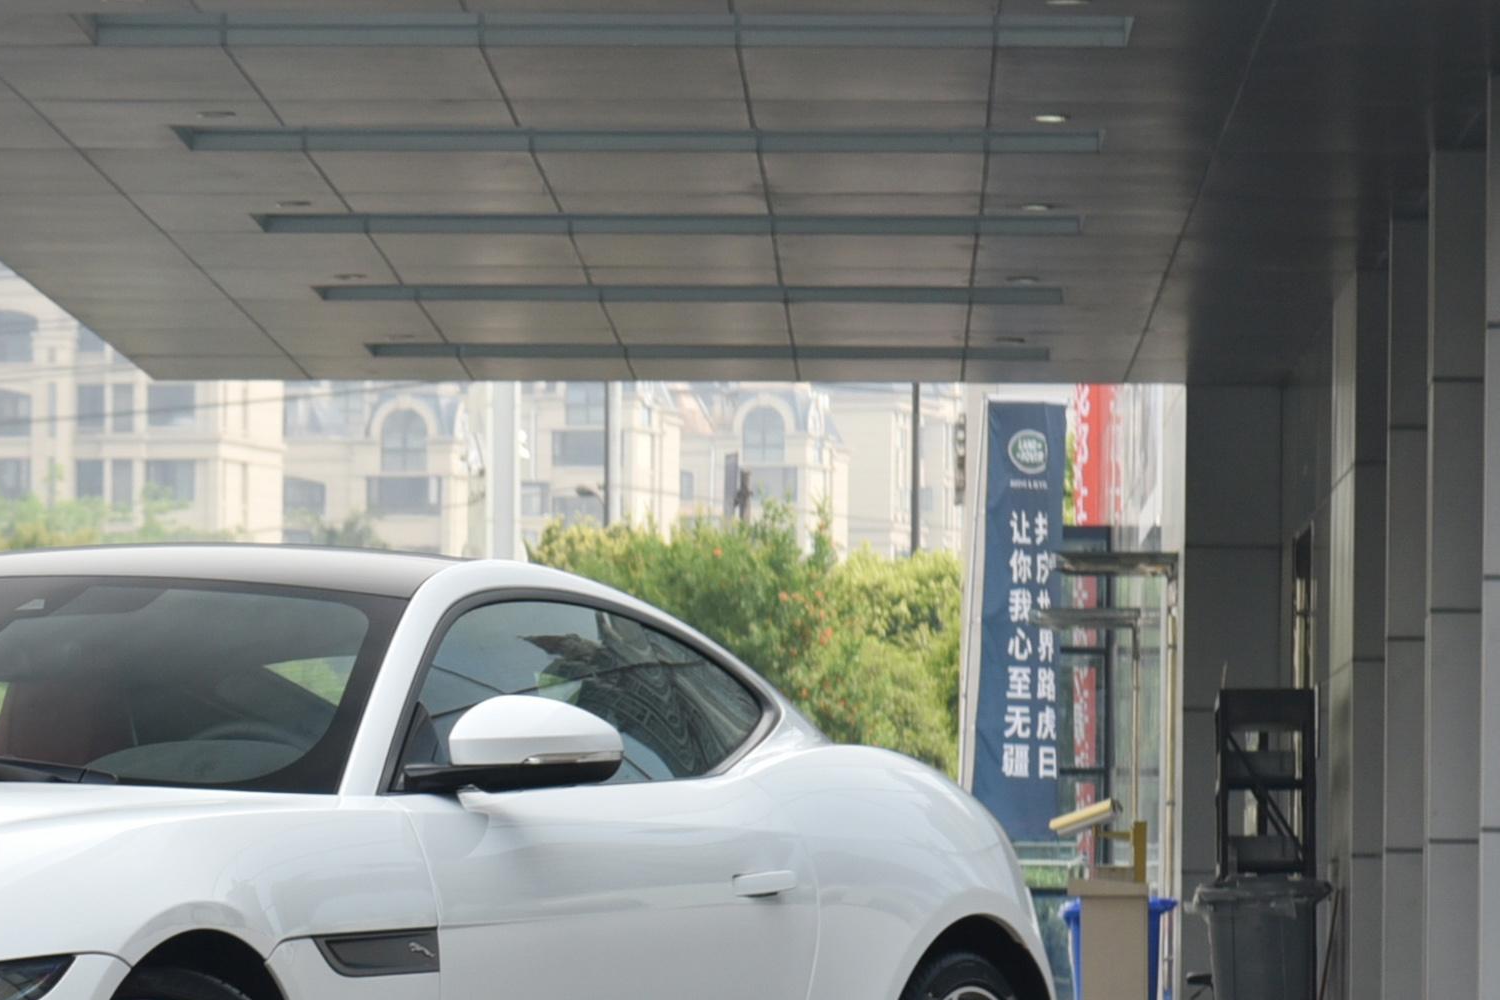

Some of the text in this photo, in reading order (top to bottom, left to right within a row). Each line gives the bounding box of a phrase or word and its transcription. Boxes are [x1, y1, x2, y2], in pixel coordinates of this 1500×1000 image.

[1001, 509, 1032, 779] 让你我心至无疆
